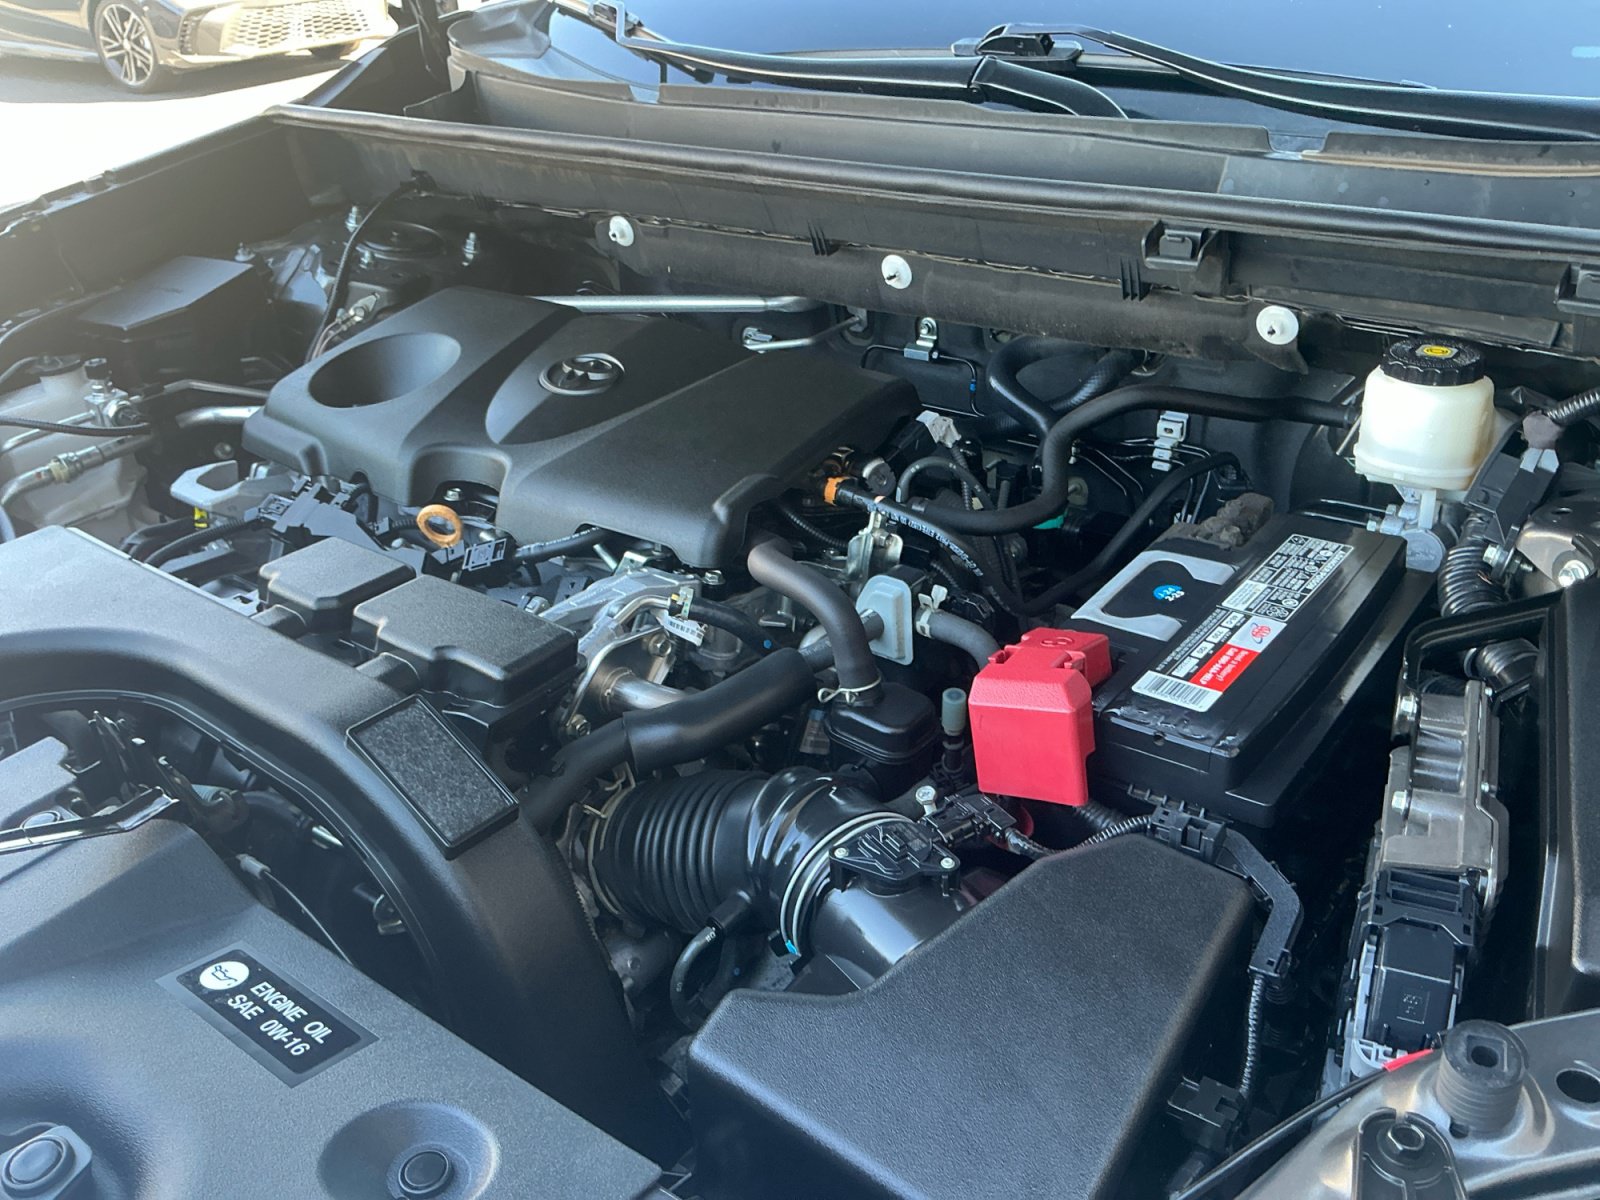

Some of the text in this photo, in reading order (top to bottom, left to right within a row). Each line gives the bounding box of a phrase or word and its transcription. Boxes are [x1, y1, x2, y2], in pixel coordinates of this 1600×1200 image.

[227, 994, 311, 1056] SAE 0W-16
[250, 981, 333, 1044] ENGINE OIL
